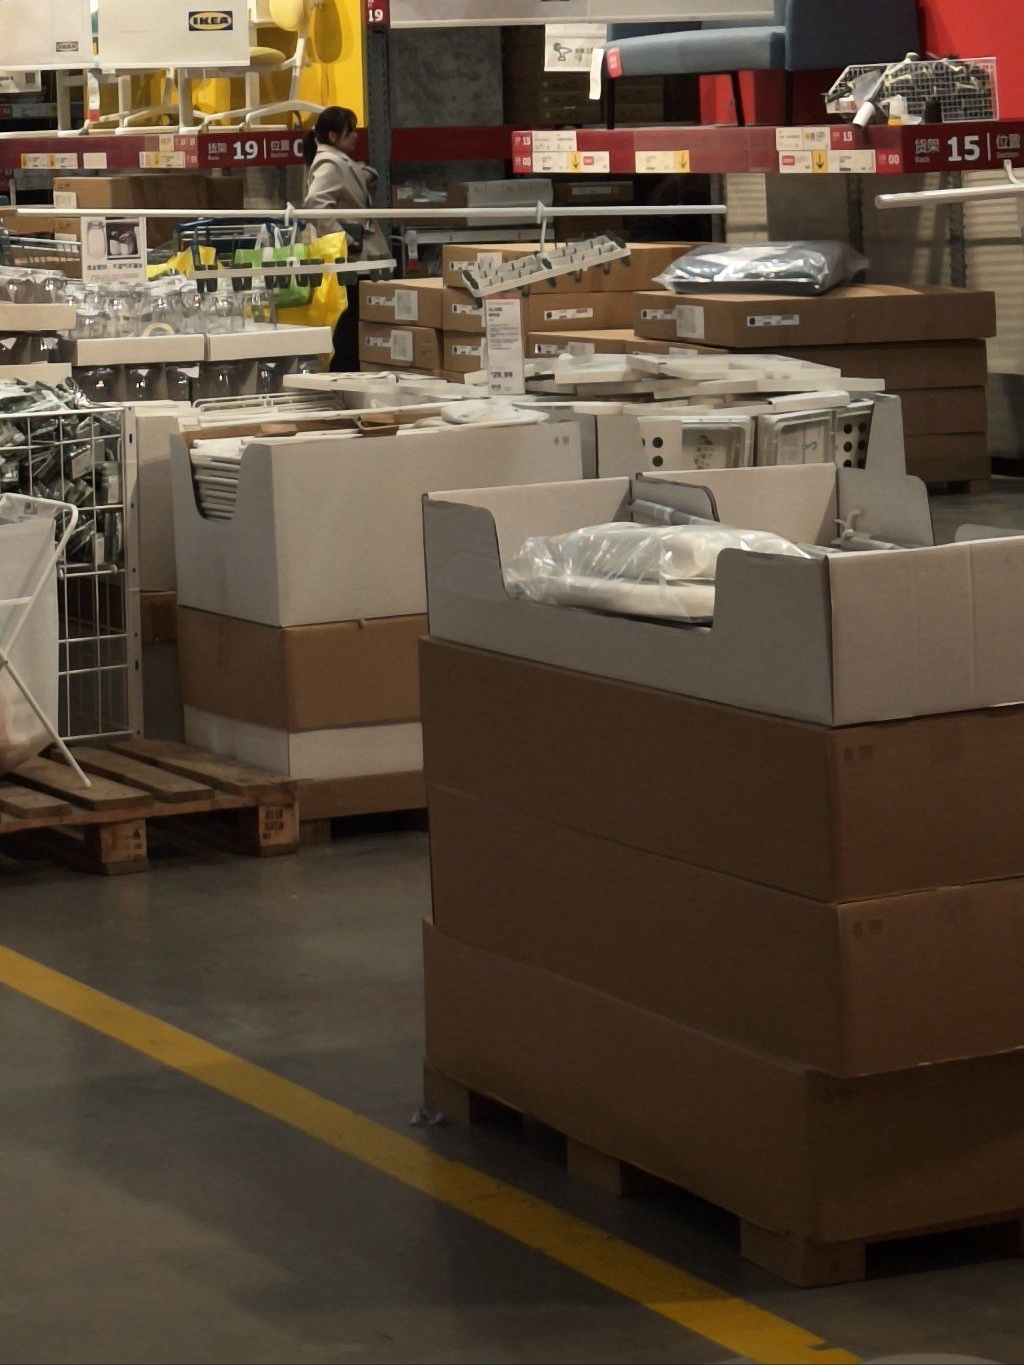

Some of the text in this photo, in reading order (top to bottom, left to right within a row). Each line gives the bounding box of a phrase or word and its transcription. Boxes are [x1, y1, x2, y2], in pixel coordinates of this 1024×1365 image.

[368, 8, 384, 22] 19
[233, 140, 258, 160] 19
[947, 135, 980, 162] 15
